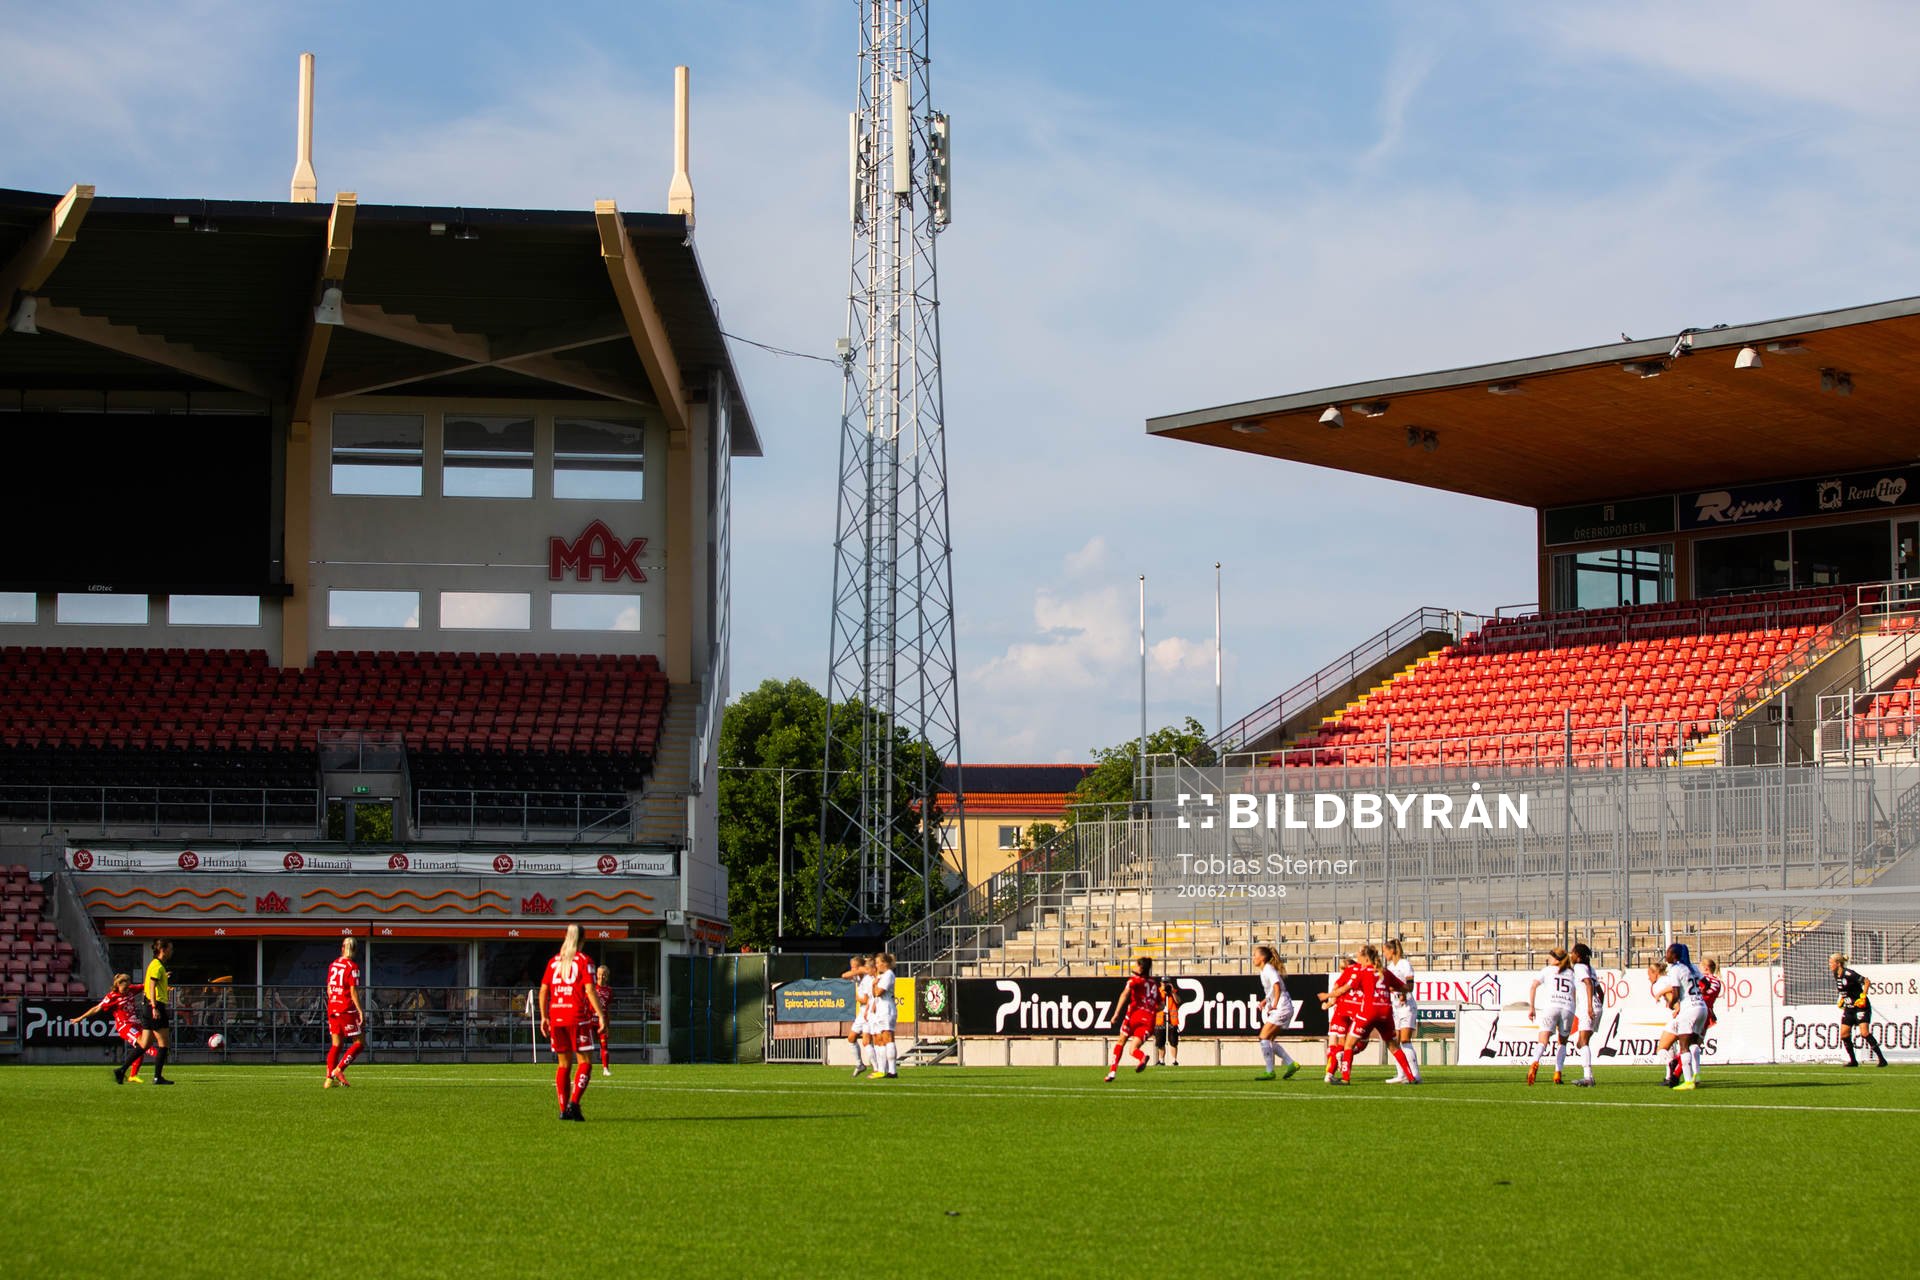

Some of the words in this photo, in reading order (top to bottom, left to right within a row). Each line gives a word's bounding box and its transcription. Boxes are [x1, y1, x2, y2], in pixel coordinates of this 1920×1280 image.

[1847, 486, 1876, 500] Rent
[1877, 481, 1902, 497] Hus
[1574, 522, 1646, 540] ÖREBROPORTEN
[549, 519, 648, 582] MAX
[97, 855, 142, 868] Humana
[203, 856, 247, 868] Humana
[307, 857, 352, 870] Humana
[412, 858, 457, 870] Humana
[517, 859, 562, 872] Humana
[621, 859, 665, 871] Humana
[255, 890, 289, 912] MAX
[521, 892, 555, 914] MAX
[329, 966, 345, 986] 21
[551, 960, 579, 985] 20
[1415, 981, 1471, 1003] HRN
[1554, 977, 1570, 993] 15
[1869, 982, 1904, 995] sson
[1908, 978, 1918, 995] &
[784, 998, 803, 1010] Epiroc
[803, 998, 819, 1008] Rock
[819, 998, 835, 1008] Drills
[835, 998, 845, 1008] AB
[995, 980, 1112, 1034] Printoz
[26, 1007, 120, 1040] Printoz
